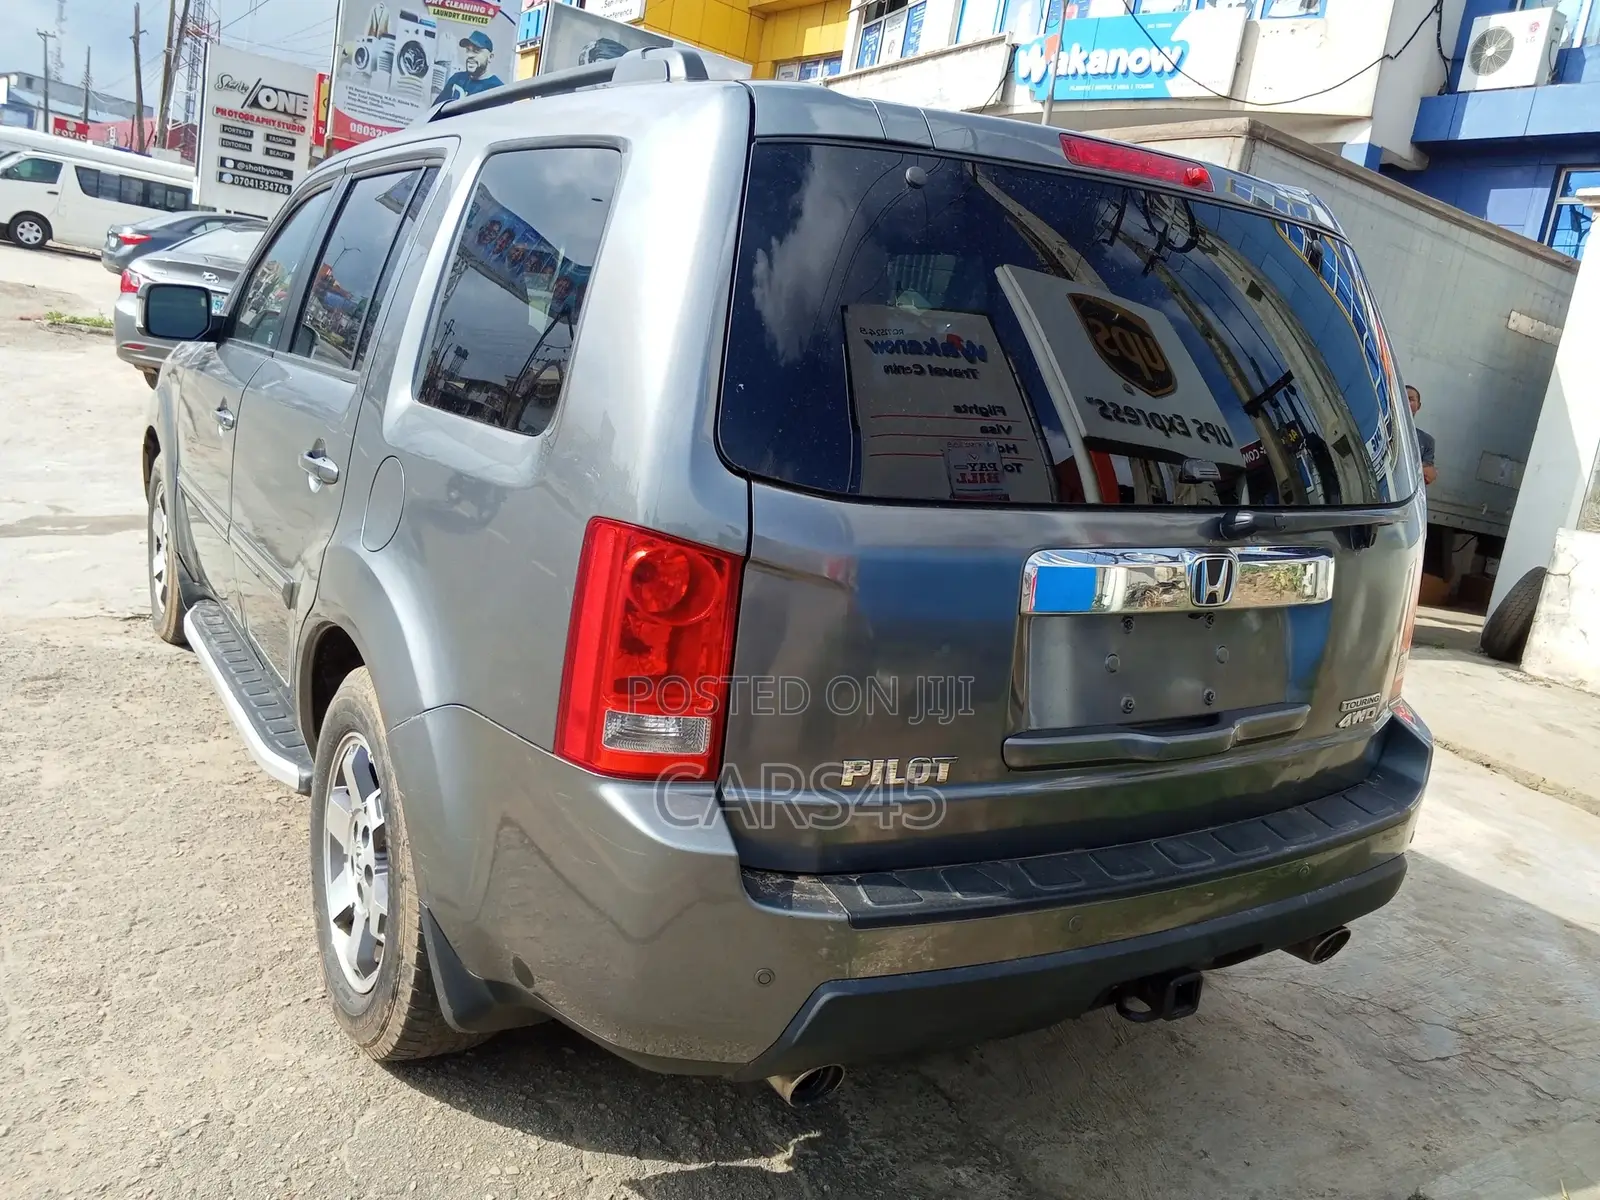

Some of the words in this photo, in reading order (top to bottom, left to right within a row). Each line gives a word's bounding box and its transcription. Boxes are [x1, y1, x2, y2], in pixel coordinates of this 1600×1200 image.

[446, 0, 486, 14] CLEANING
[433, 8, 460, 20] LAUNDRY
[461, 14, 489, 25] SERVICES
[258, 86, 308, 118] ONE
[216, 106, 276, 126] PHOTOGRAPHY
[277, 121, 306, 134] STUDIO
[224, 126, 251, 136] PORTRAIT
[222, 140, 250, 151] EDITORIAL
[269, 136, 293, 145] FASHION
[269, 150, 290, 158] BEAUTY
[236, 161, 288, 179] @shotbyone_
[234, 176, 289, 194] 07041554766
[1345, 696, 1380, 710] TOURING
[1337, 706, 1377, 728] 4WD
[840, 756, 958, 787] PILOT
